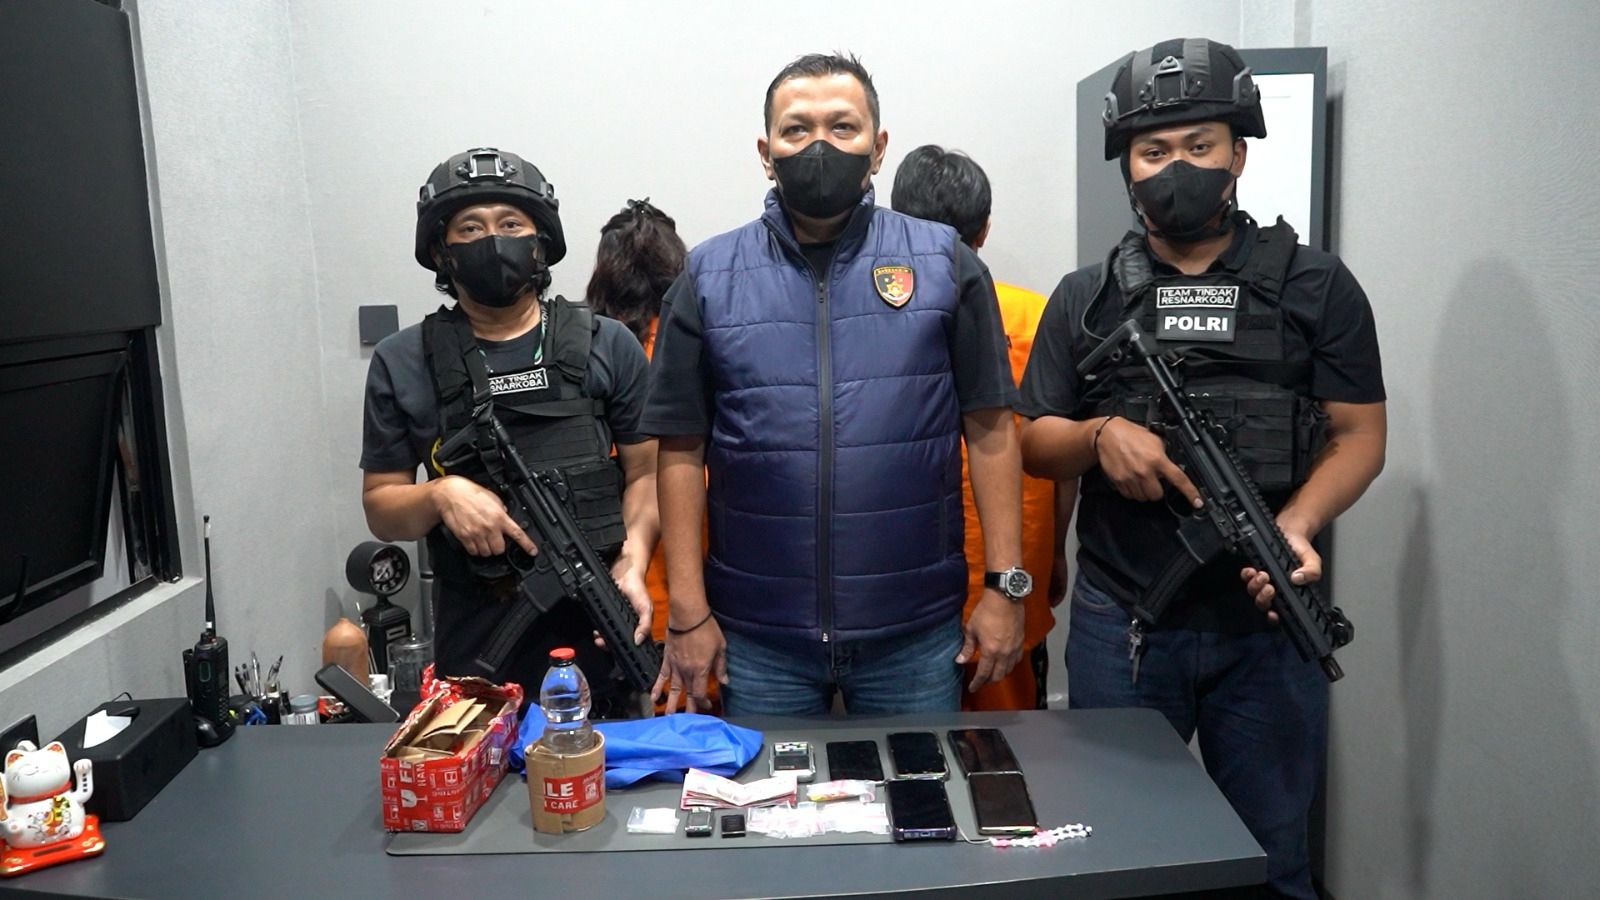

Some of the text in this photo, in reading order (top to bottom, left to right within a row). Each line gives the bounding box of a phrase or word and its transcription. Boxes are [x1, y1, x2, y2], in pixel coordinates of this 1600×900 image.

[1161, 288, 1233, 297] TEAM TINDAK
[1161, 296, 1232, 305] RESNARKOBA
[1164, 316, 1228, 331] POLRI
[489, 372, 543, 387] AM TINDAK
[490, 379, 543, 392] SNARKOBA
[544, 782, 574, 797] LE
[551, 800, 579, 810] CARE
